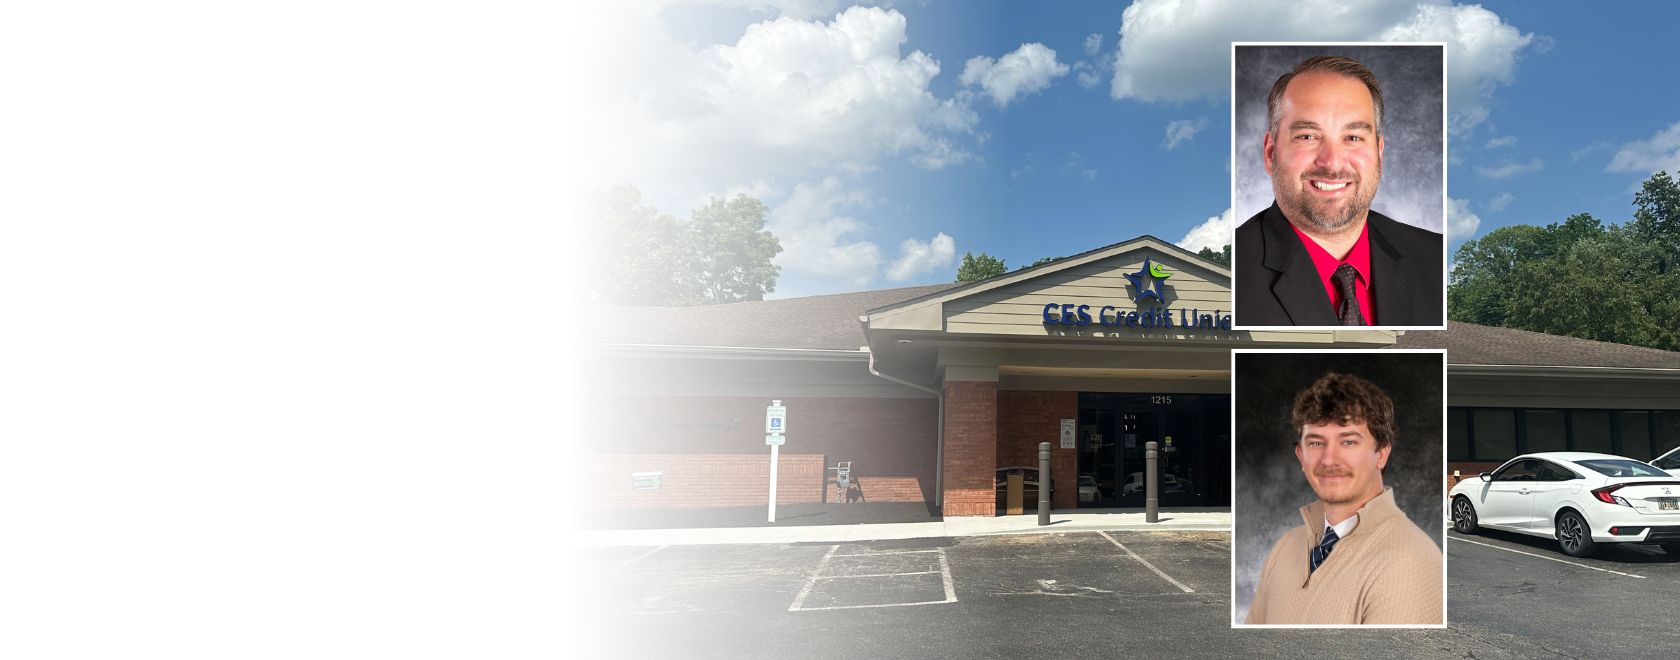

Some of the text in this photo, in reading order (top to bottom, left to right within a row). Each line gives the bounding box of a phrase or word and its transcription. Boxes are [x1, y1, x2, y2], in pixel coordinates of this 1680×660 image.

[1043, 303, 1092, 326] CES
[1100, 305, 1174, 329] Credit
[1151, 395, 1172, 404] 1215
